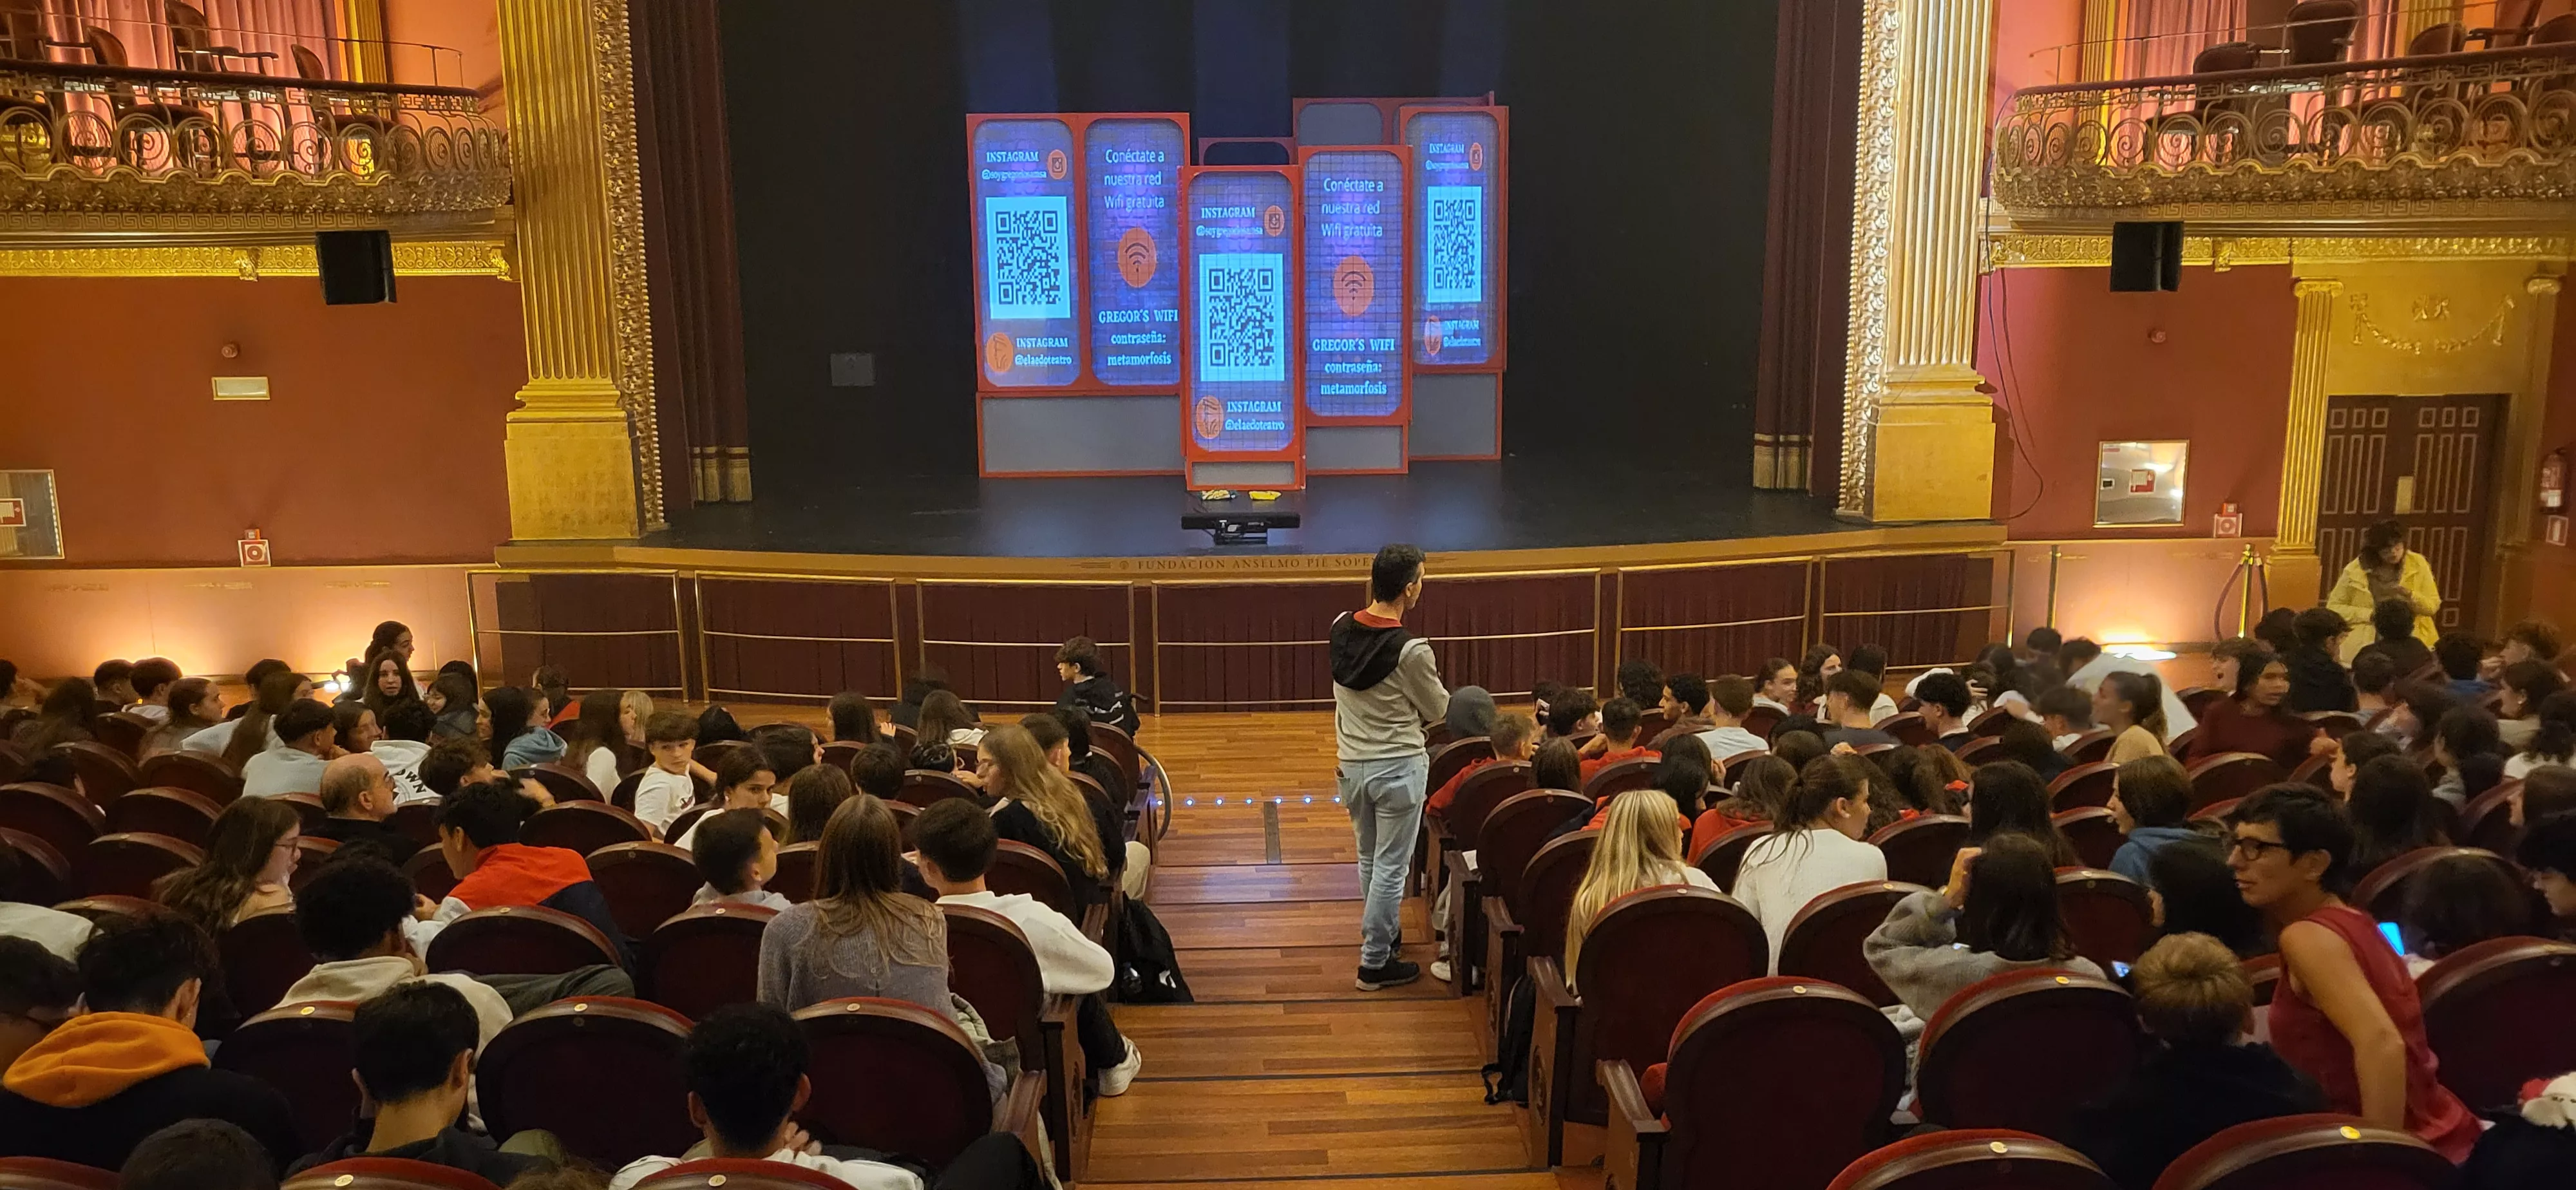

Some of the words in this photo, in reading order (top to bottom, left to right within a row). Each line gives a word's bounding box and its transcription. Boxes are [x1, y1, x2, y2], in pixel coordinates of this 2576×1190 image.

[986, 151, 1039, 163] INSTAGRAM
[1105, 148, 1156, 164] Conéctate
[1157, 151, 1165, 163] a
[1104, 173, 1142, 186] nuestra
[1144, 171, 1162, 186] red
[1323, 177, 1376, 192] Conéctate
[1376, 181, 1384, 192] a
[1104, 194, 1124, 209] Wifi
[1125, 194, 1165, 213] gratuita
[1321, 202, 1361, 214] nuestra
[1361, 200, 1381, 214] red
[1201, 207, 1256, 219] INSTAGRAM
[1321, 223, 1341, 238] Wifi
[1343, 223, 1383, 241] gratuita
[1153, 308, 1179, 322] WIFI
[1016, 337, 1068, 348] INSTAGRAM
[1110, 330, 1166, 345] contraseña:
[1369, 338, 1396, 352] WIFI
[1107, 351, 1172, 366] metamorfosis
[1325, 359, 1383, 373] contraseña:
[1320, 380, 1387, 395] metamorfosis
[1226, 401, 1282, 413] INSTAGRAM
[1232, 558, 1300, 569] ANSELMO
[1334, 556, 1376, 567] SOPE
